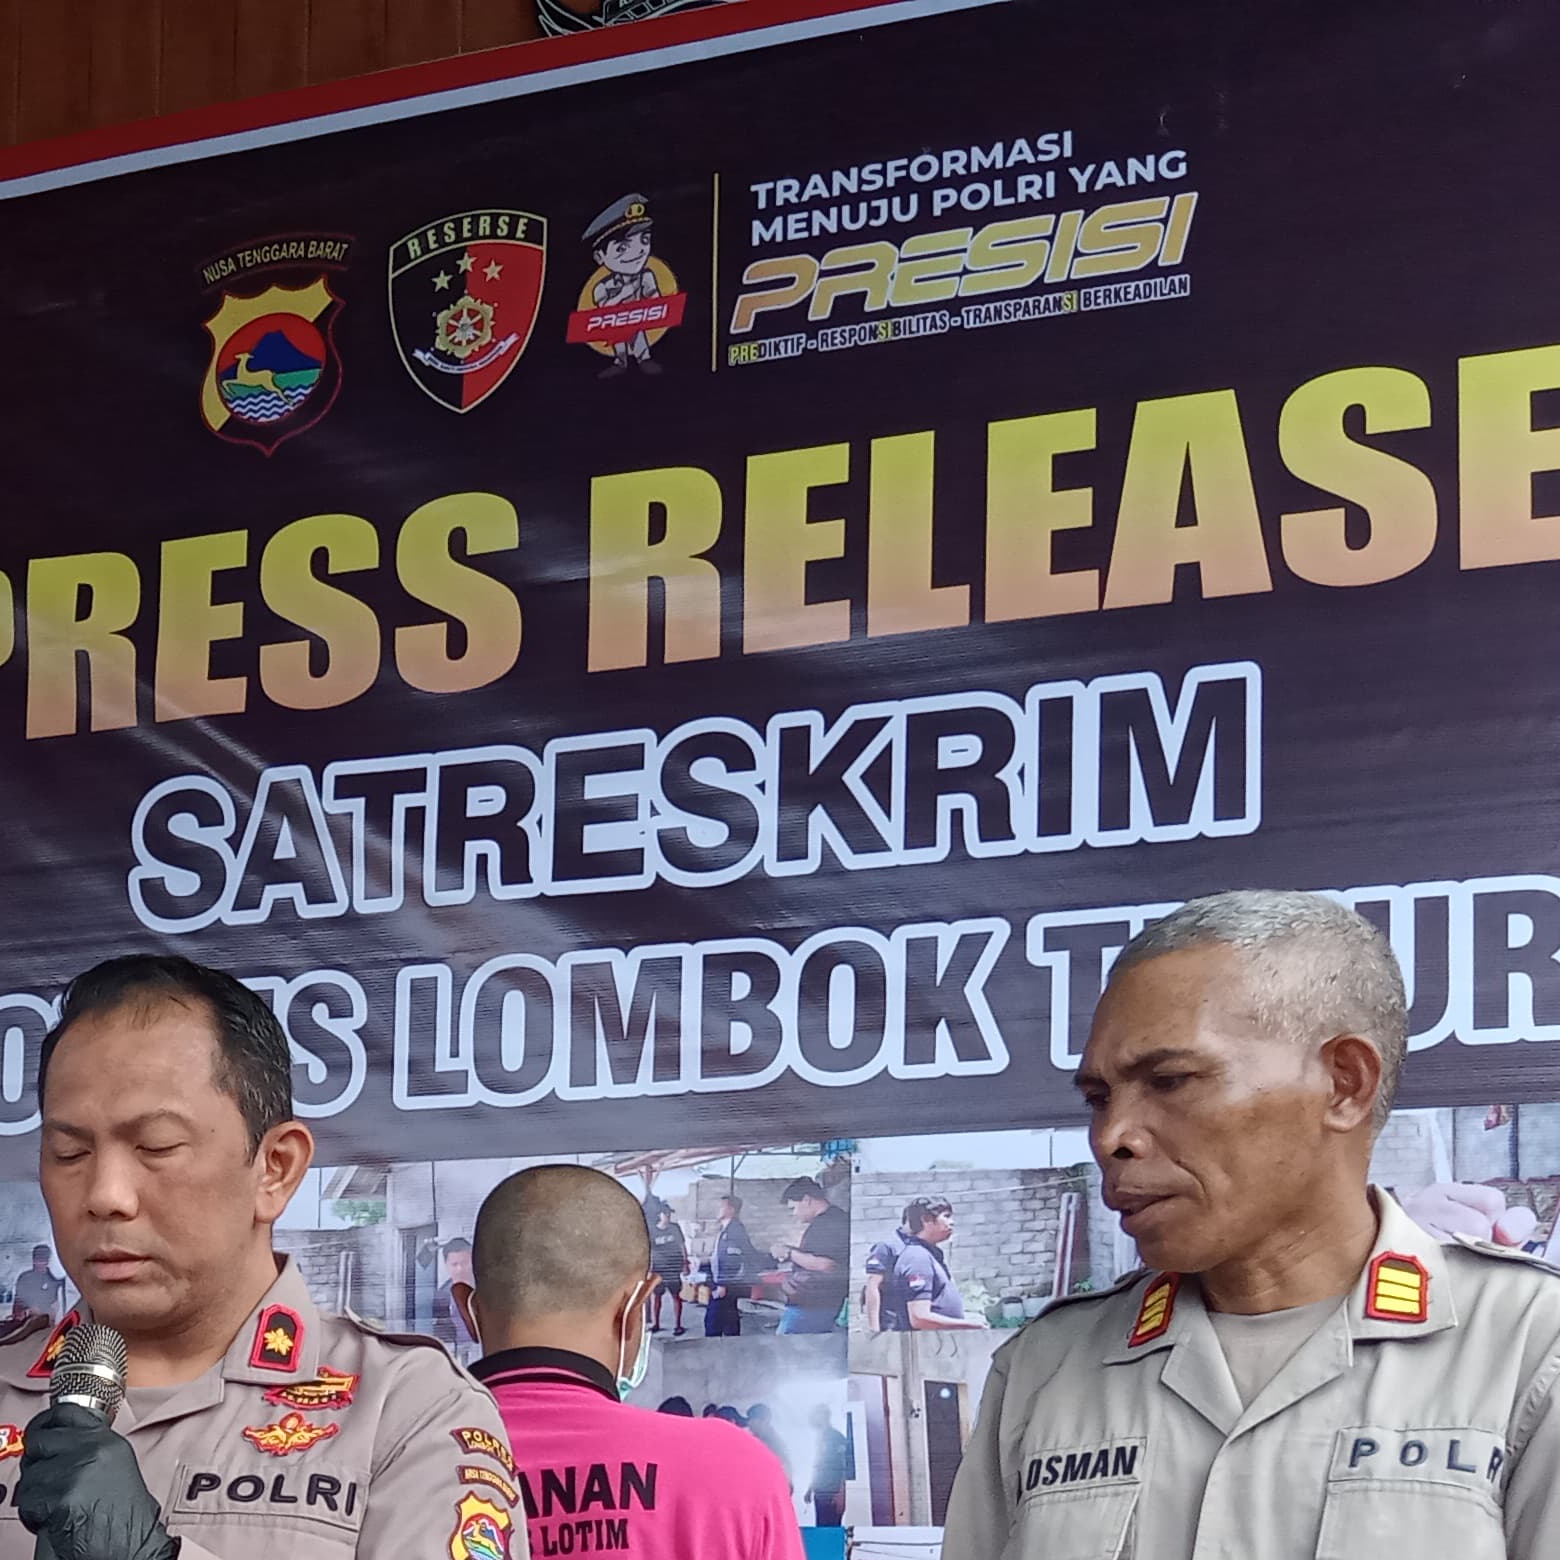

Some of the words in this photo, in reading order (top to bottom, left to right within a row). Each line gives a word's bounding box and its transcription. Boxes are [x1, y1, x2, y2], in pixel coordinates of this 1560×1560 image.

[750, 129, 1073, 211] TRANSFORMASI
[751, 191, 919, 247] MENUJU
[932, 170, 1056, 217] POLRI
[1068, 149, 1188, 194] YANG
[202, 253, 237, 285] NUSA
[237, 239, 306, 268] TENGGARA
[306, 239, 349, 260] BARAT
[406, 215, 530, 260] RESERSE
[729, 191, 1199, 335] PRESISI
[585, 304, 668, 333] PRESISI
[728, 333, 807, 366] PREDIKTIF
[963, 290, 1078, 331] TRANSPARANSI
[1082, 274, 1190, 310] BERKEADILAN
[588, 344, 1560, 675] RELEASE
[127, 660, 1262, 934] SATRESKRIM
[393, 914, 1009, 1109] LOMBOK
[185, 1471, 357, 1517] POLRI
[1347, 1437, 1504, 1484] POLR
[540, 1518, 629, 1557] LOTIM
